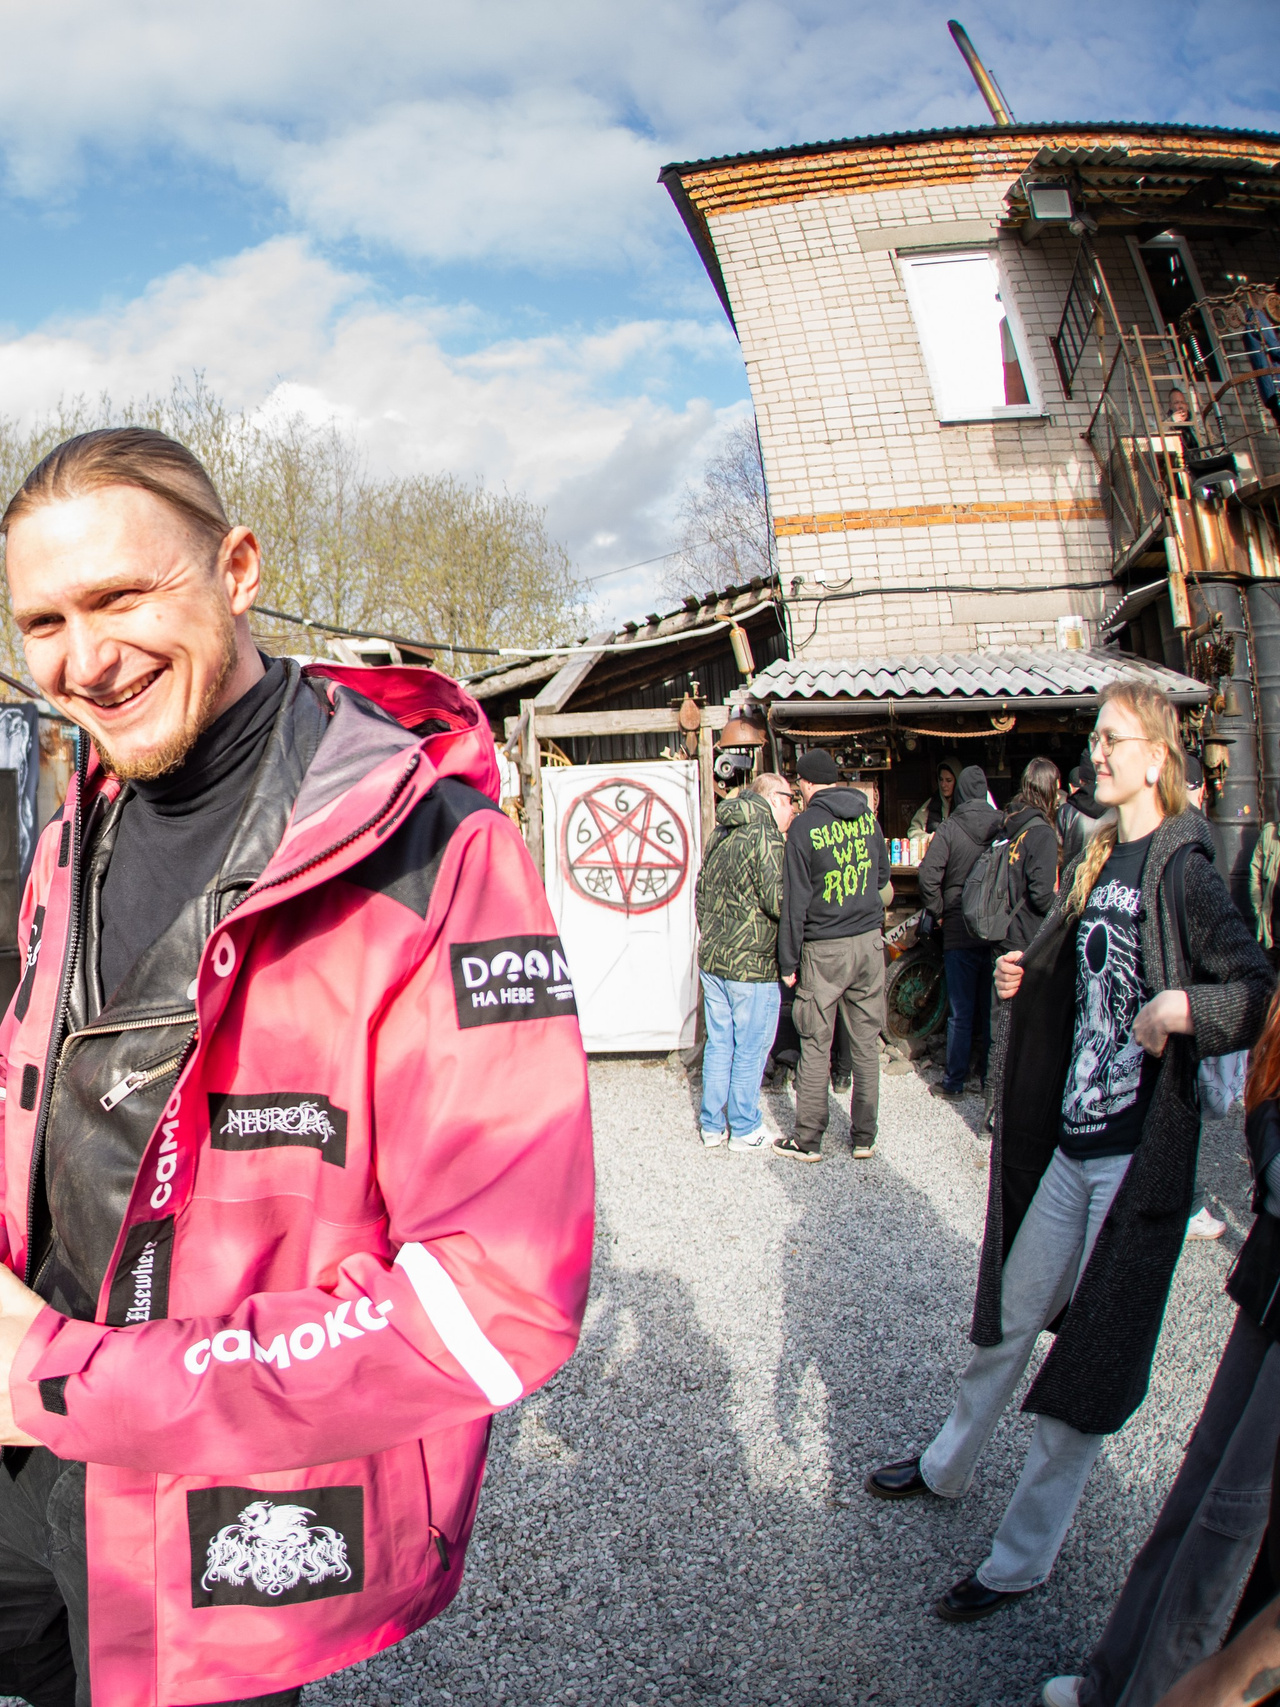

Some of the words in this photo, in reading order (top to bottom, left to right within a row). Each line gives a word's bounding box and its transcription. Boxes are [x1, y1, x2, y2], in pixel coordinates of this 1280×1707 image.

[615, 790, 629, 812] 6
[577, 818, 591, 844] 6
[656, 820, 674, 844] 6
[809, 812, 877, 850] SLOWLY
[832, 837, 868, 868] WE
[822, 859, 872, 906] ROT
[471, 990, 499, 1008] НА
[500, 987, 535, 1004] НЕВЕ
[125, 1241, 158, 1323] Elsewhere
